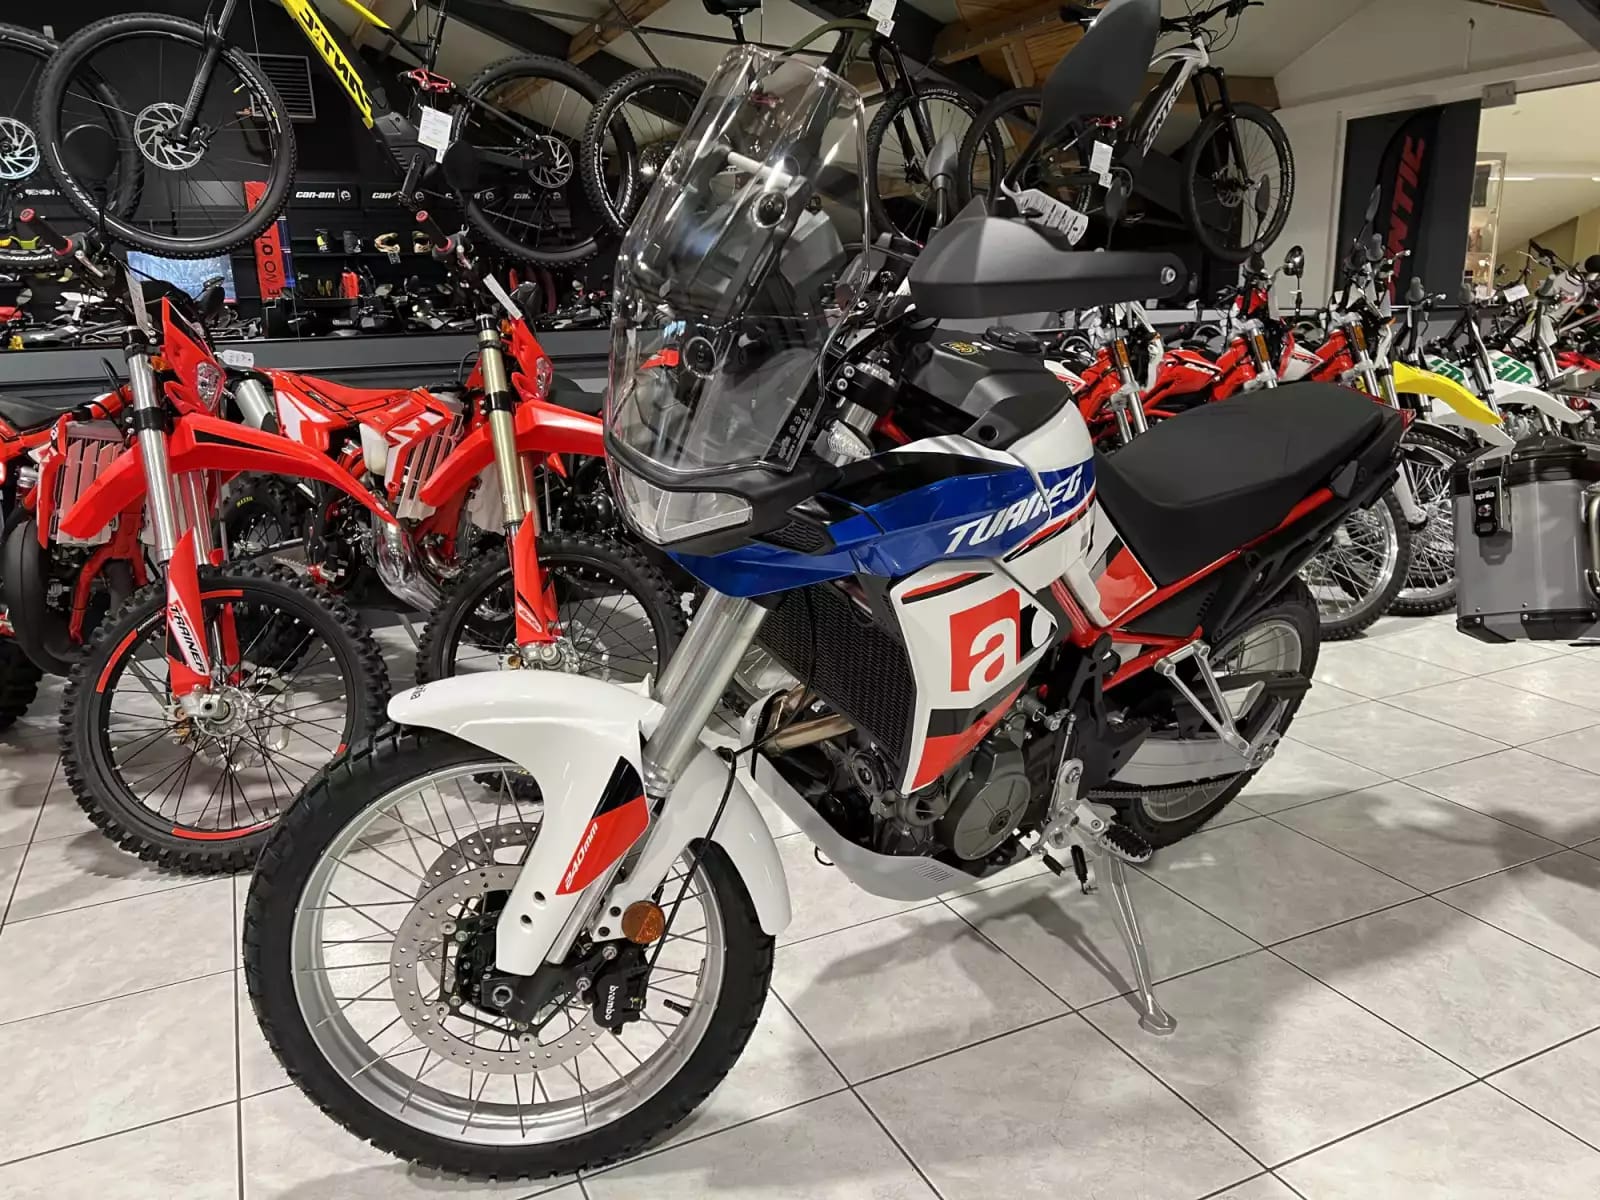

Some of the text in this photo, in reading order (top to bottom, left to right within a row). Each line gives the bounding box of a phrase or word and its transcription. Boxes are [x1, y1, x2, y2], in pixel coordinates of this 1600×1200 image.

[295, 191, 336, 199] can-am
[170, 605, 206, 674] TRAINER
[564, 821, 599, 892] 240mm
[604, 985, 619, 1020] brembo
